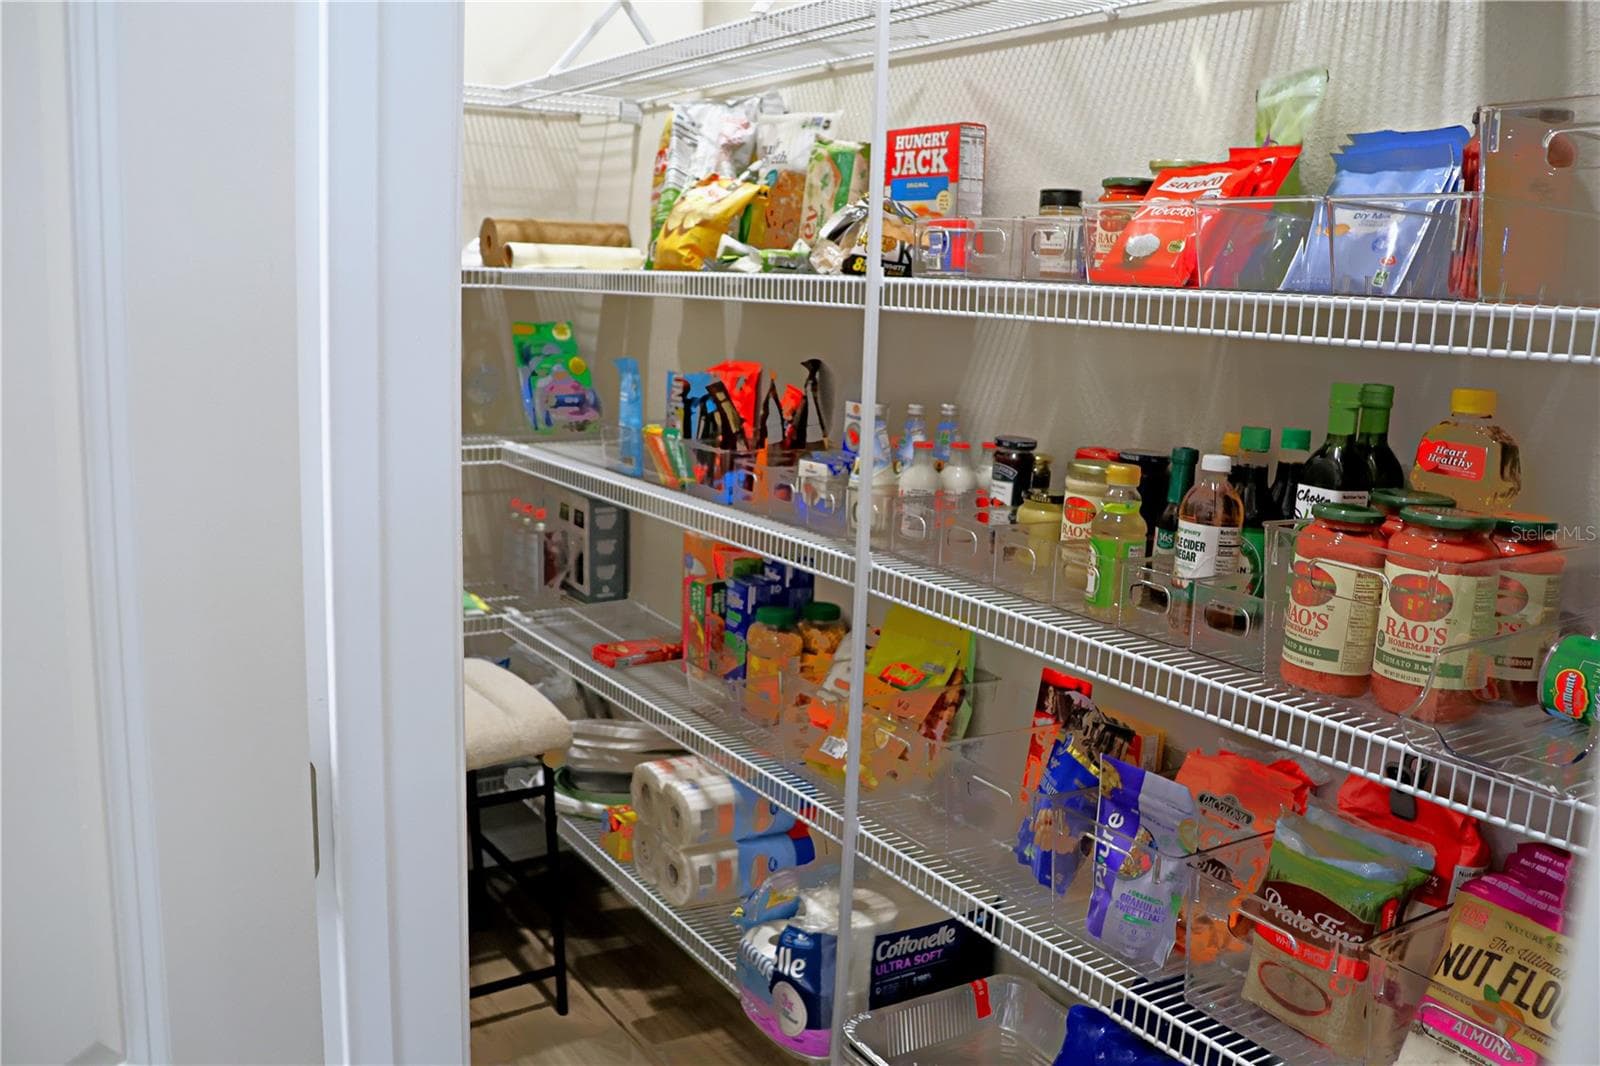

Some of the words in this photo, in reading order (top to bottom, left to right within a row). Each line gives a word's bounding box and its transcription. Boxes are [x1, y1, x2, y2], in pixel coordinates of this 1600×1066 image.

[895, 131, 949, 150] HUNGRY
[891, 148, 949, 176] JACK
[1435, 445, 1467, 458] Heart
[1428, 453, 1473, 470] Healthy
[1177, 547, 1197, 562] EGAR
[1183, 538, 1206, 552] CIDER
[1385, 616, 1448, 646] RAO'S
[1382, 654, 1411, 668] TOMATO
[1562, 672, 1578, 703] Monte
[875, 924, 956, 962] Cottonelle
[1488, 936, 1514, 955] The
[875, 957, 912, 976] ULTRA
[914, 948, 944, 965] SOFT
[1434, 941, 1503, 988] NUT
[1497, 961, 1567, 1032] FLO
